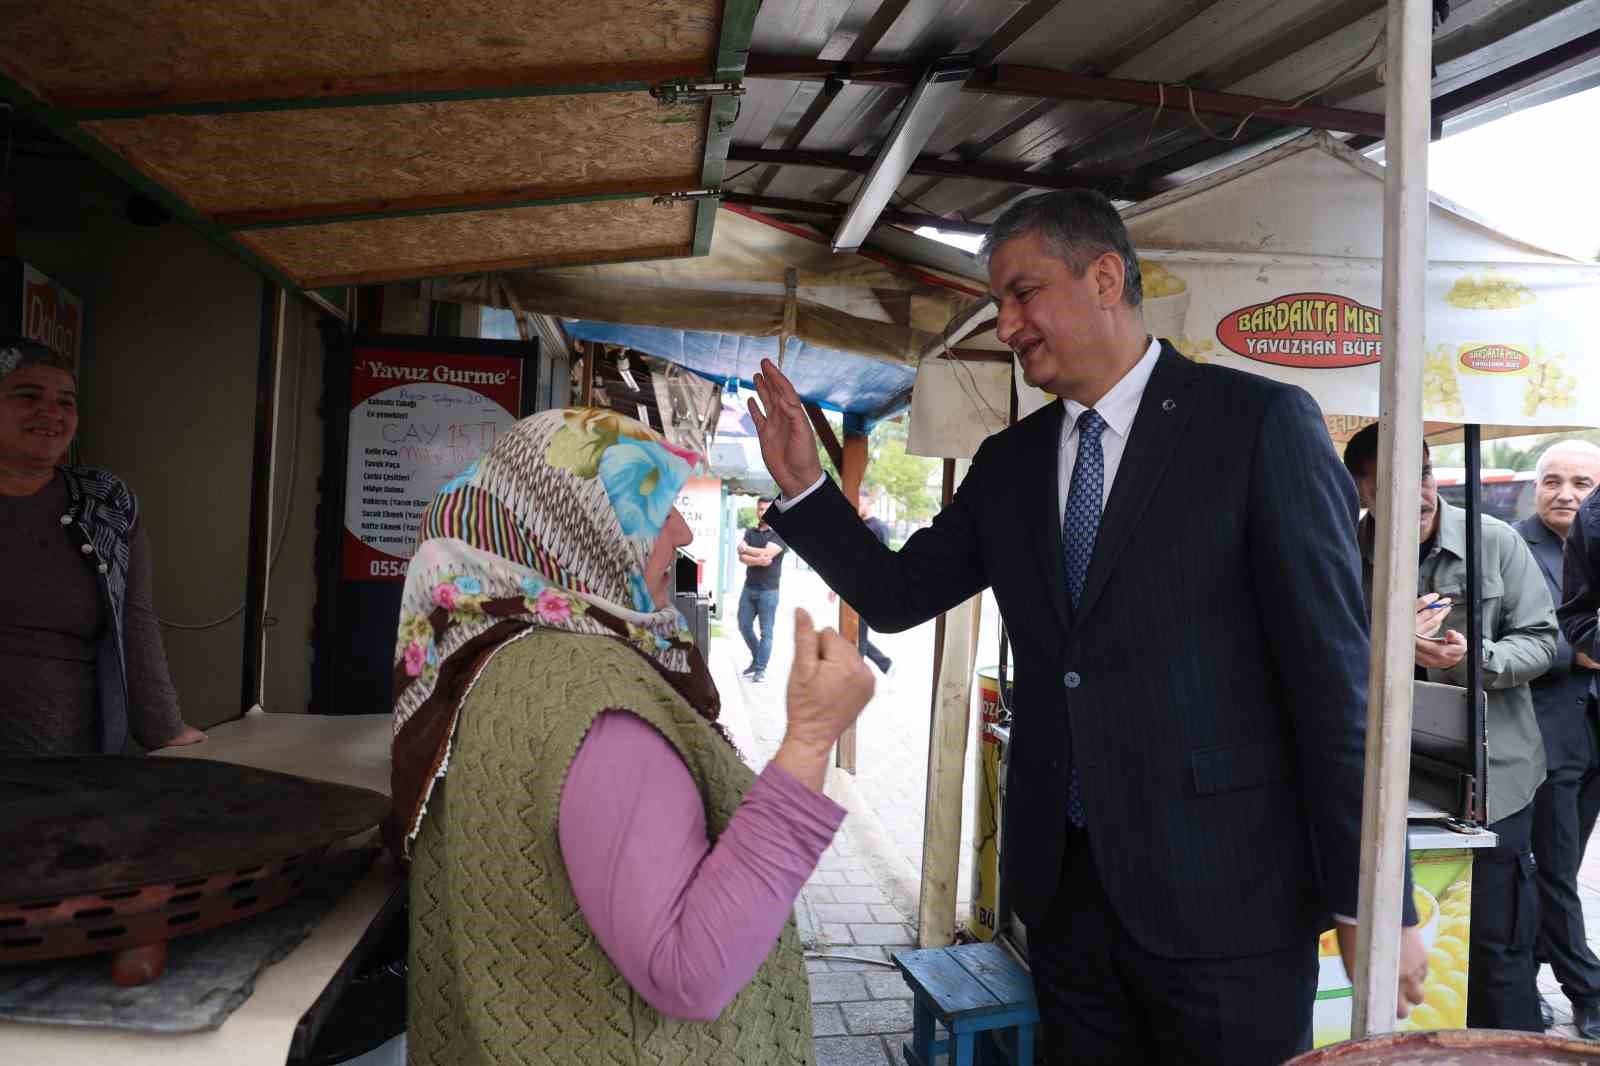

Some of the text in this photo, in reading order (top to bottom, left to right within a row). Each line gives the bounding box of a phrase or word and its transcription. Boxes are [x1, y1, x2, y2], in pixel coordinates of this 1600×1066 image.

[1238, 300, 1338, 336] BARDAKTA
[1246, 338, 1337, 355] YAVUZHAN
[370, 560, 408, 577] 0554
